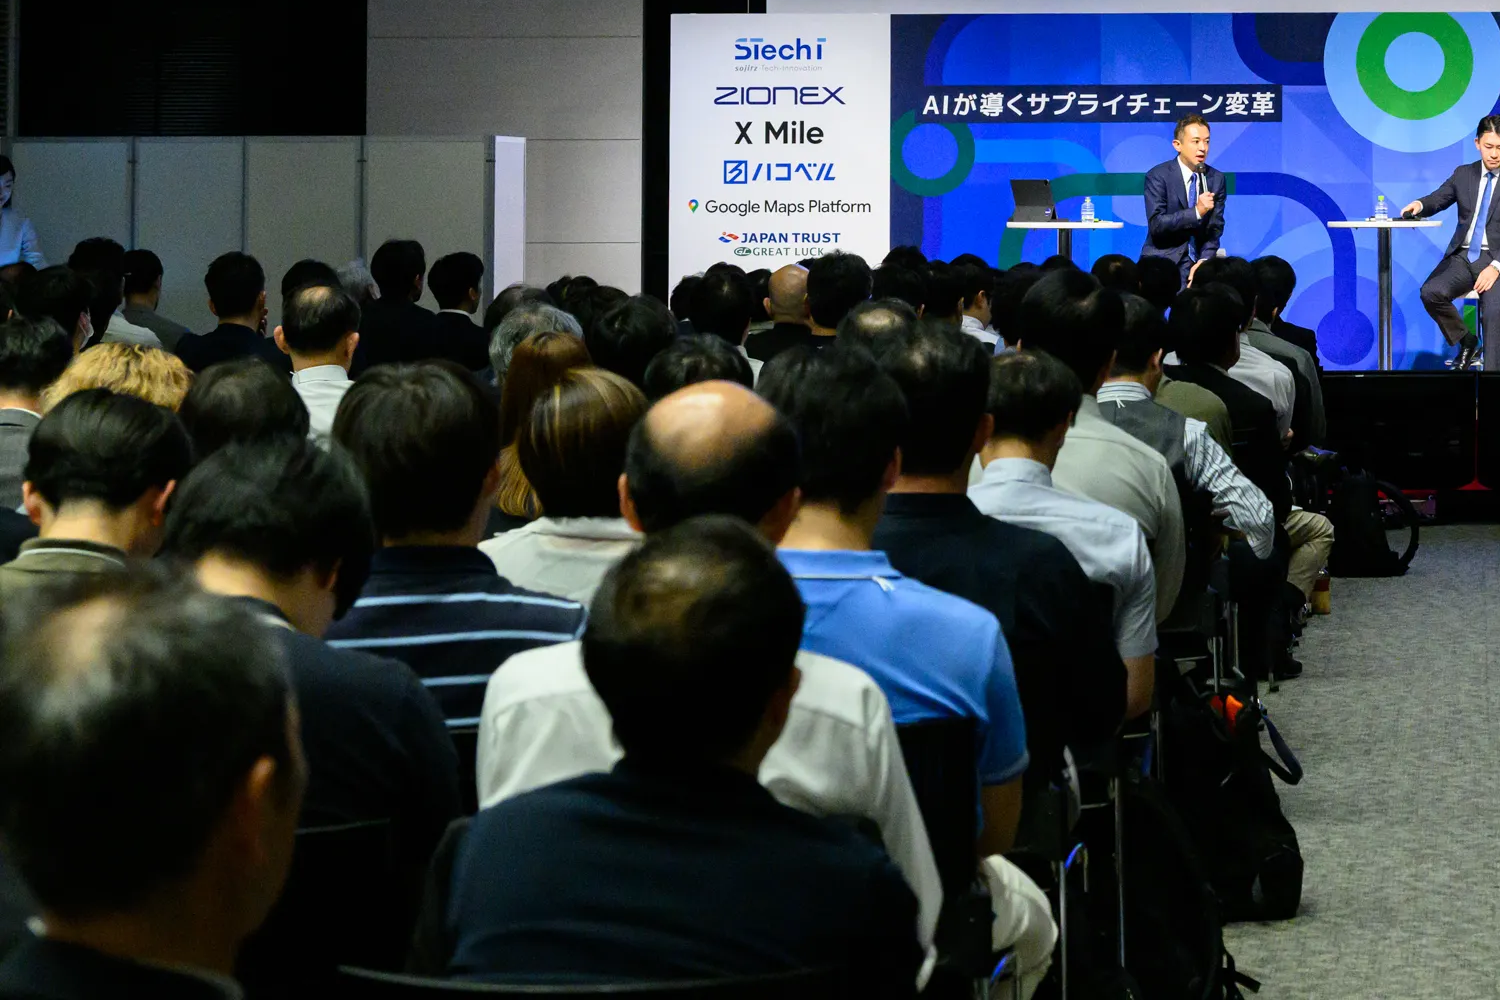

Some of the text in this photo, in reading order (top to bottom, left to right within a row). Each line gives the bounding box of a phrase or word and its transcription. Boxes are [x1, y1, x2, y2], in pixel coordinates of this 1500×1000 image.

[922, 91, 1275, 117] AIが導くサプライチェーン変革
[734, 120, 824, 145] X Mile
[752, 163, 836, 181] ハコベル
[705, 200, 871, 217] Google Maps Platform
[741, 233, 841, 243] JAPAN TRUST
[753, 247, 790, 256] GREAT
[795, 247, 824, 256] LUCK
